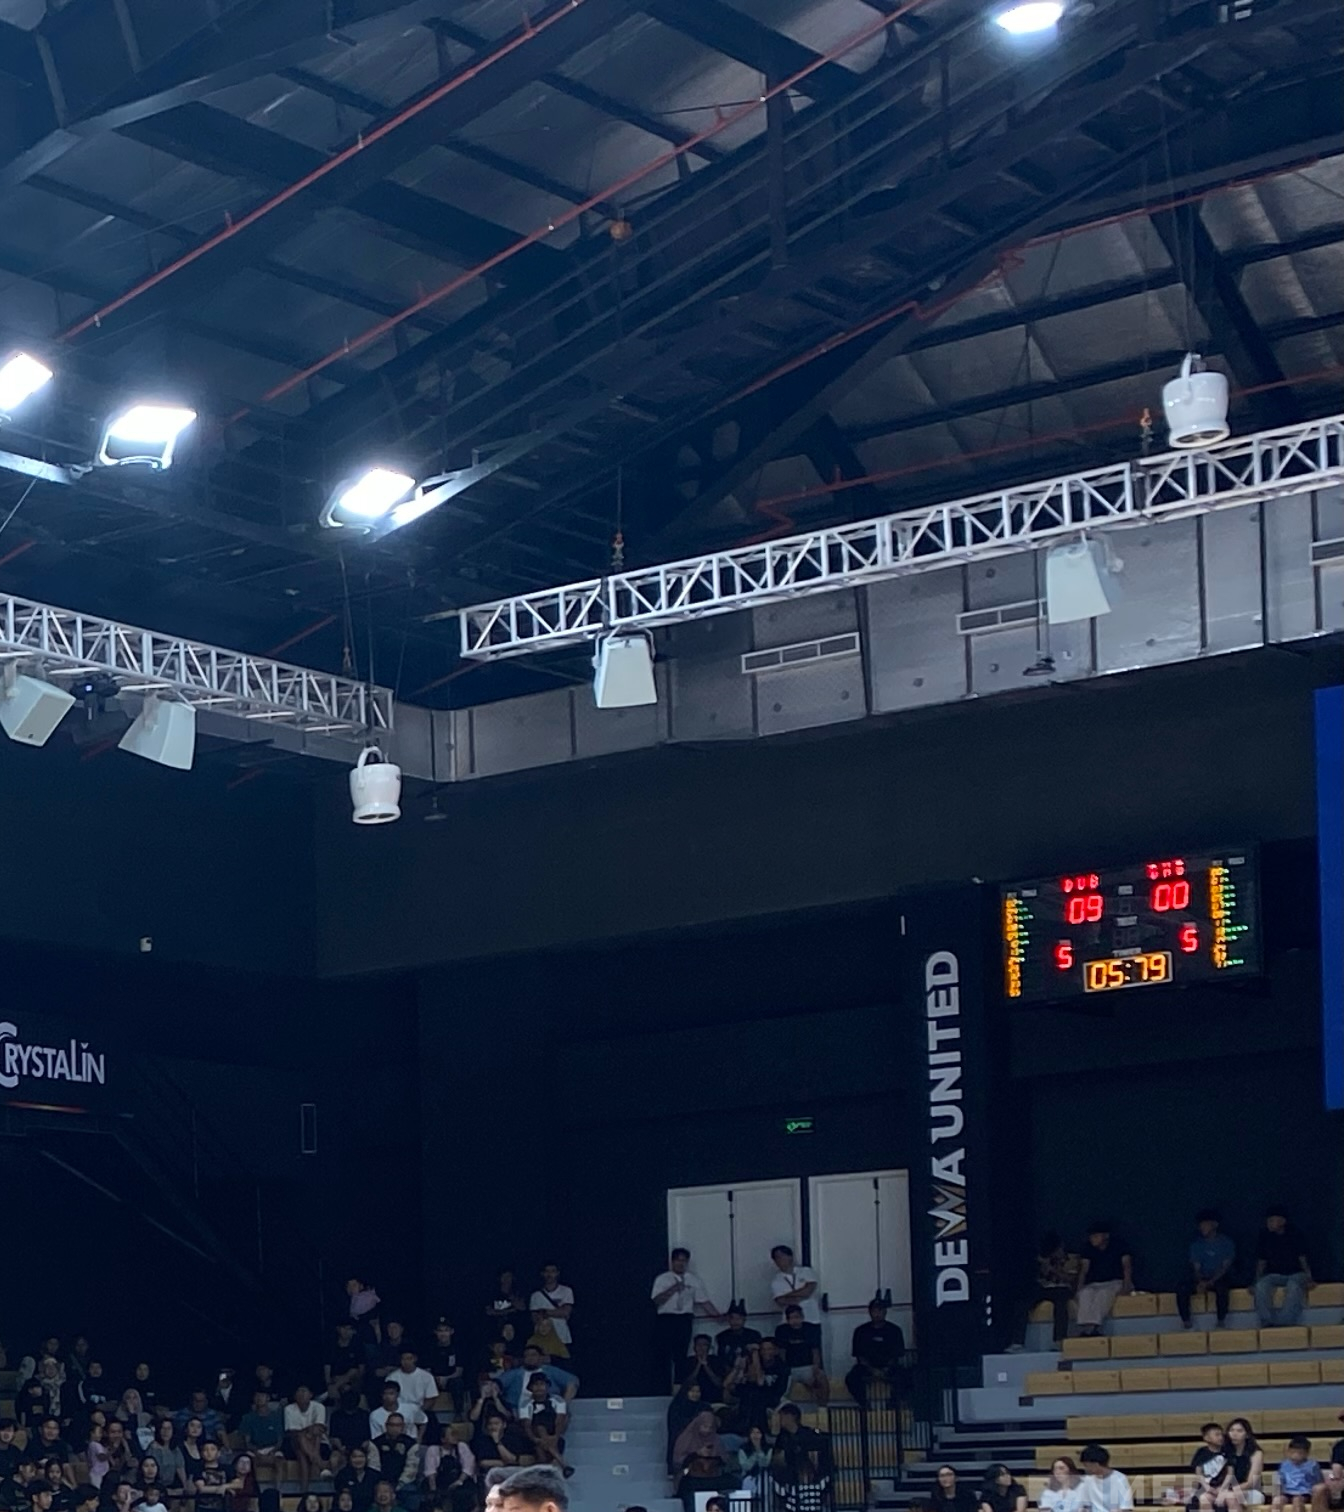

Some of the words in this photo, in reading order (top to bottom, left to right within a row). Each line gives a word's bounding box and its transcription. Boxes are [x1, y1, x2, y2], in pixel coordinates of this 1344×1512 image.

[1068, 895, 1103, 924] 09
[1152, 881, 1190, 912] 00
[924, 950, 967, 1141] UNITED
[927, 1147, 970, 1308] DEWA
